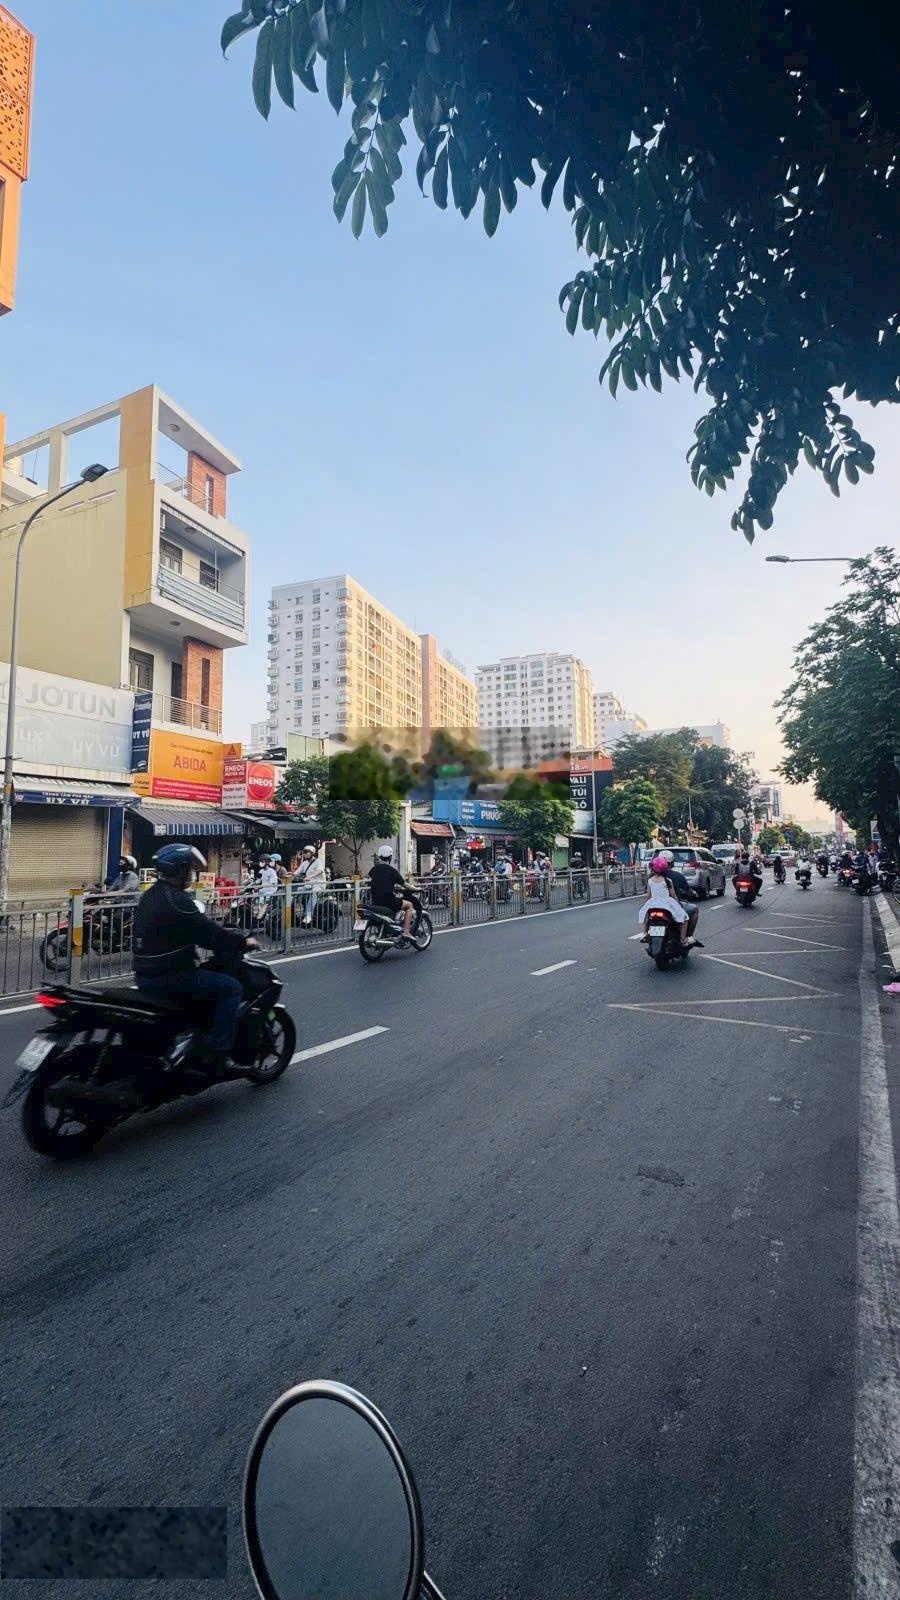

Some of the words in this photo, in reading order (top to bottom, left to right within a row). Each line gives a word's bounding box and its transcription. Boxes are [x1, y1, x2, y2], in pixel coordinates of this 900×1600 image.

[24, 680, 117, 719] JOTUN
[173, 755, 207, 773] ABIDA
[224, 765, 246, 773] ENEOS
[248, 776, 274, 788] ENEOS
[571, 786, 587, 796] TÚI
[247, 801, 265, 809] MOTOR
